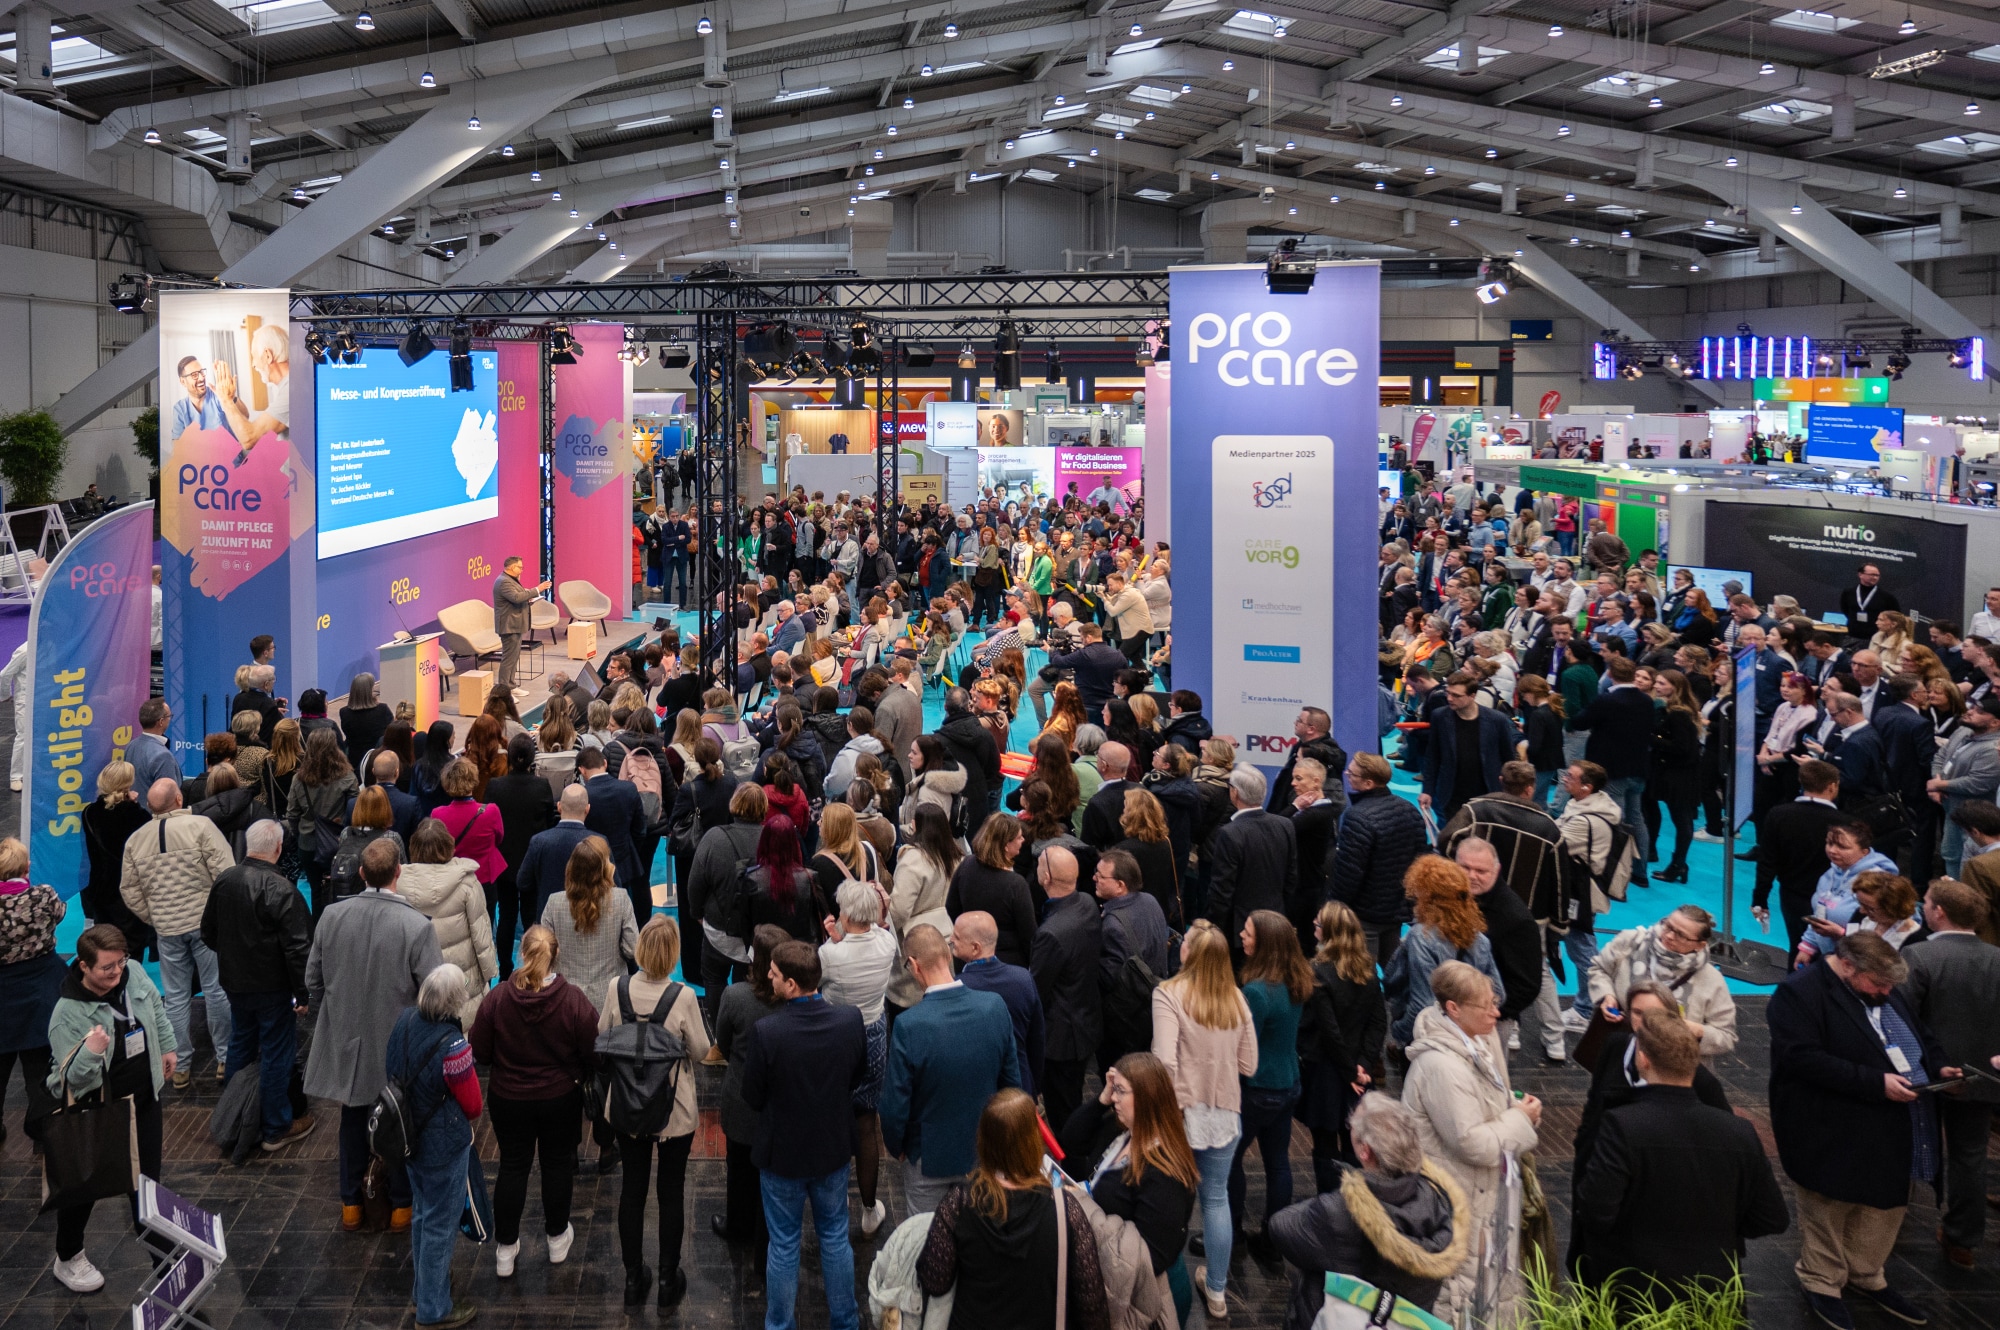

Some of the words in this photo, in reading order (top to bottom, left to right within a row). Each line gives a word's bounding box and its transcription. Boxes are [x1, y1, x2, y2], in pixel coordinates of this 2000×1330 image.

[1188, 312, 1292, 364] pro
[1218, 348, 1359, 386] care
[330, 388, 362, 400] Messe-
[362, 386, 378, 399] und
[380, 385, 446, 400] Kongresseröffnung
[502, 395, 526, 412] care
[566, 433, 591, 448] pro
[572, 444, 608, 456] care
[1061, 453, 1074, 461] Wir
[1076, 453, 1123, 462] digitalisieren
[1229, 450, 1293, 459] Medienpartner
[1092, 462, 1127, 470] Business
[179, 464, 229, 494] pro
[194, 487, 262, 512] care
[352, 492, 373, 502] Deutsche
[201, 520, 235, 532] DAMIT
[237, 522, 273, 533] PFLEGE
[1824, 524, 1875, 542] nutrio
[202, 536, 249, 548] ZUKUNFT
[252, 539, 272, 549] HAT
[1245, 539, 1282, 548] CARE
[1768, 534, 1820, 546] Digitalisierung
[1801, 544, 1851, 555] Seniorenheime
[1866, 551, 1903, 562] Rehakliniken
[468, 555, 483, 574] pro
[472, 563, 491, 580] care
[70, 562, 116, 590] pro
[84, 574, 143, 598] care
[391, 577, 410, 600] pro
[396, 585, 420, 605] care
[317, 614, 331, 630] re
[419, 658, 430, 674] pro
[422, 663, 436, 676] care
[1248, 695, 1302, 704] Krankenhaus
[49, 668, 93, 837] Spotlight
[176, 740, 205, 751] pro-ca
